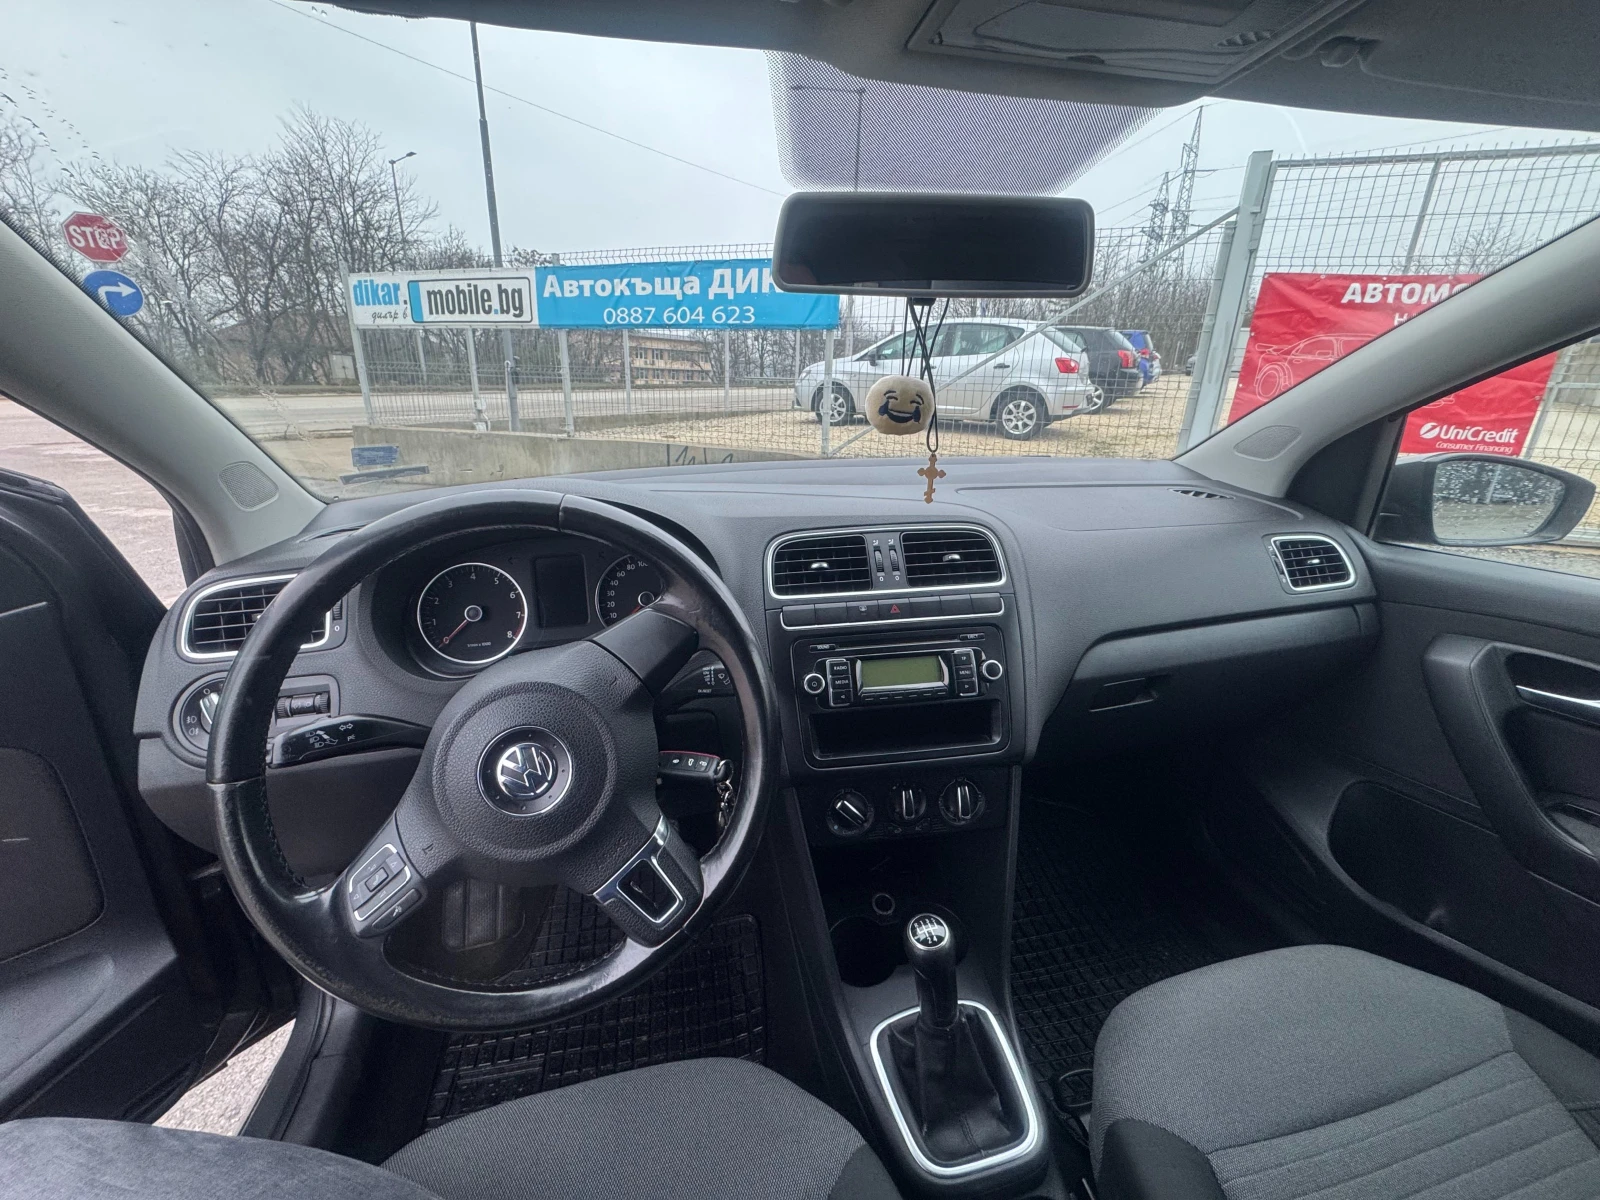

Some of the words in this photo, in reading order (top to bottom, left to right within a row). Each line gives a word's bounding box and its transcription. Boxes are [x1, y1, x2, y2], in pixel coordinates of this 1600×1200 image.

[68, 225, 121, 249] STOP
[543, 275, 700, 300] Автокъща
[427, 283, 524, 318] mobile.bg
[603, 307, 656, 324] 0887
[663, 306, 706, 324] 604
[712, 305, 756, 324] 623
[1440, 424, 1519, 443] UniCredit
[1435, 441, 1474, 450] Consumer
[1475, 443, 1513, 454] Financing
[626, 563, 636, 571] 80
[470, 572, 476, 580] 4
[494, 577, 499, 585] 5
[434, 597, 440, 605] 2
[516, 611, 521, 619] 7
[506, 630, 513, 638] 8
